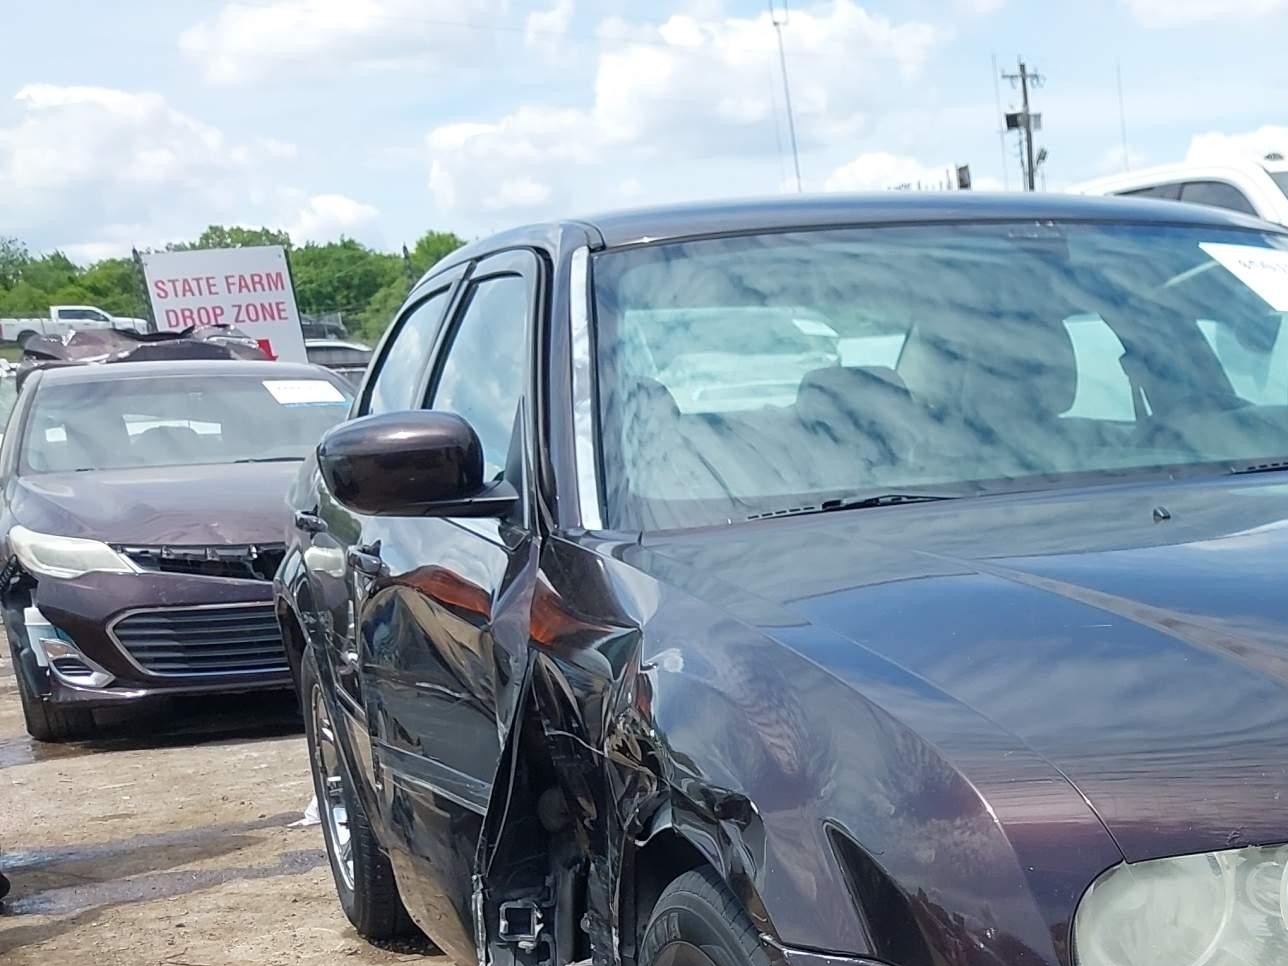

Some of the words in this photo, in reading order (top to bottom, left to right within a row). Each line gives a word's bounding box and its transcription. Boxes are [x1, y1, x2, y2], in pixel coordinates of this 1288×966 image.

[154, 276, 219, 299] STATE
[224, 271, 285, 294] FARM
[165, 305, 225, 328] DROP
[232, 301, 288, 324] ZONE
